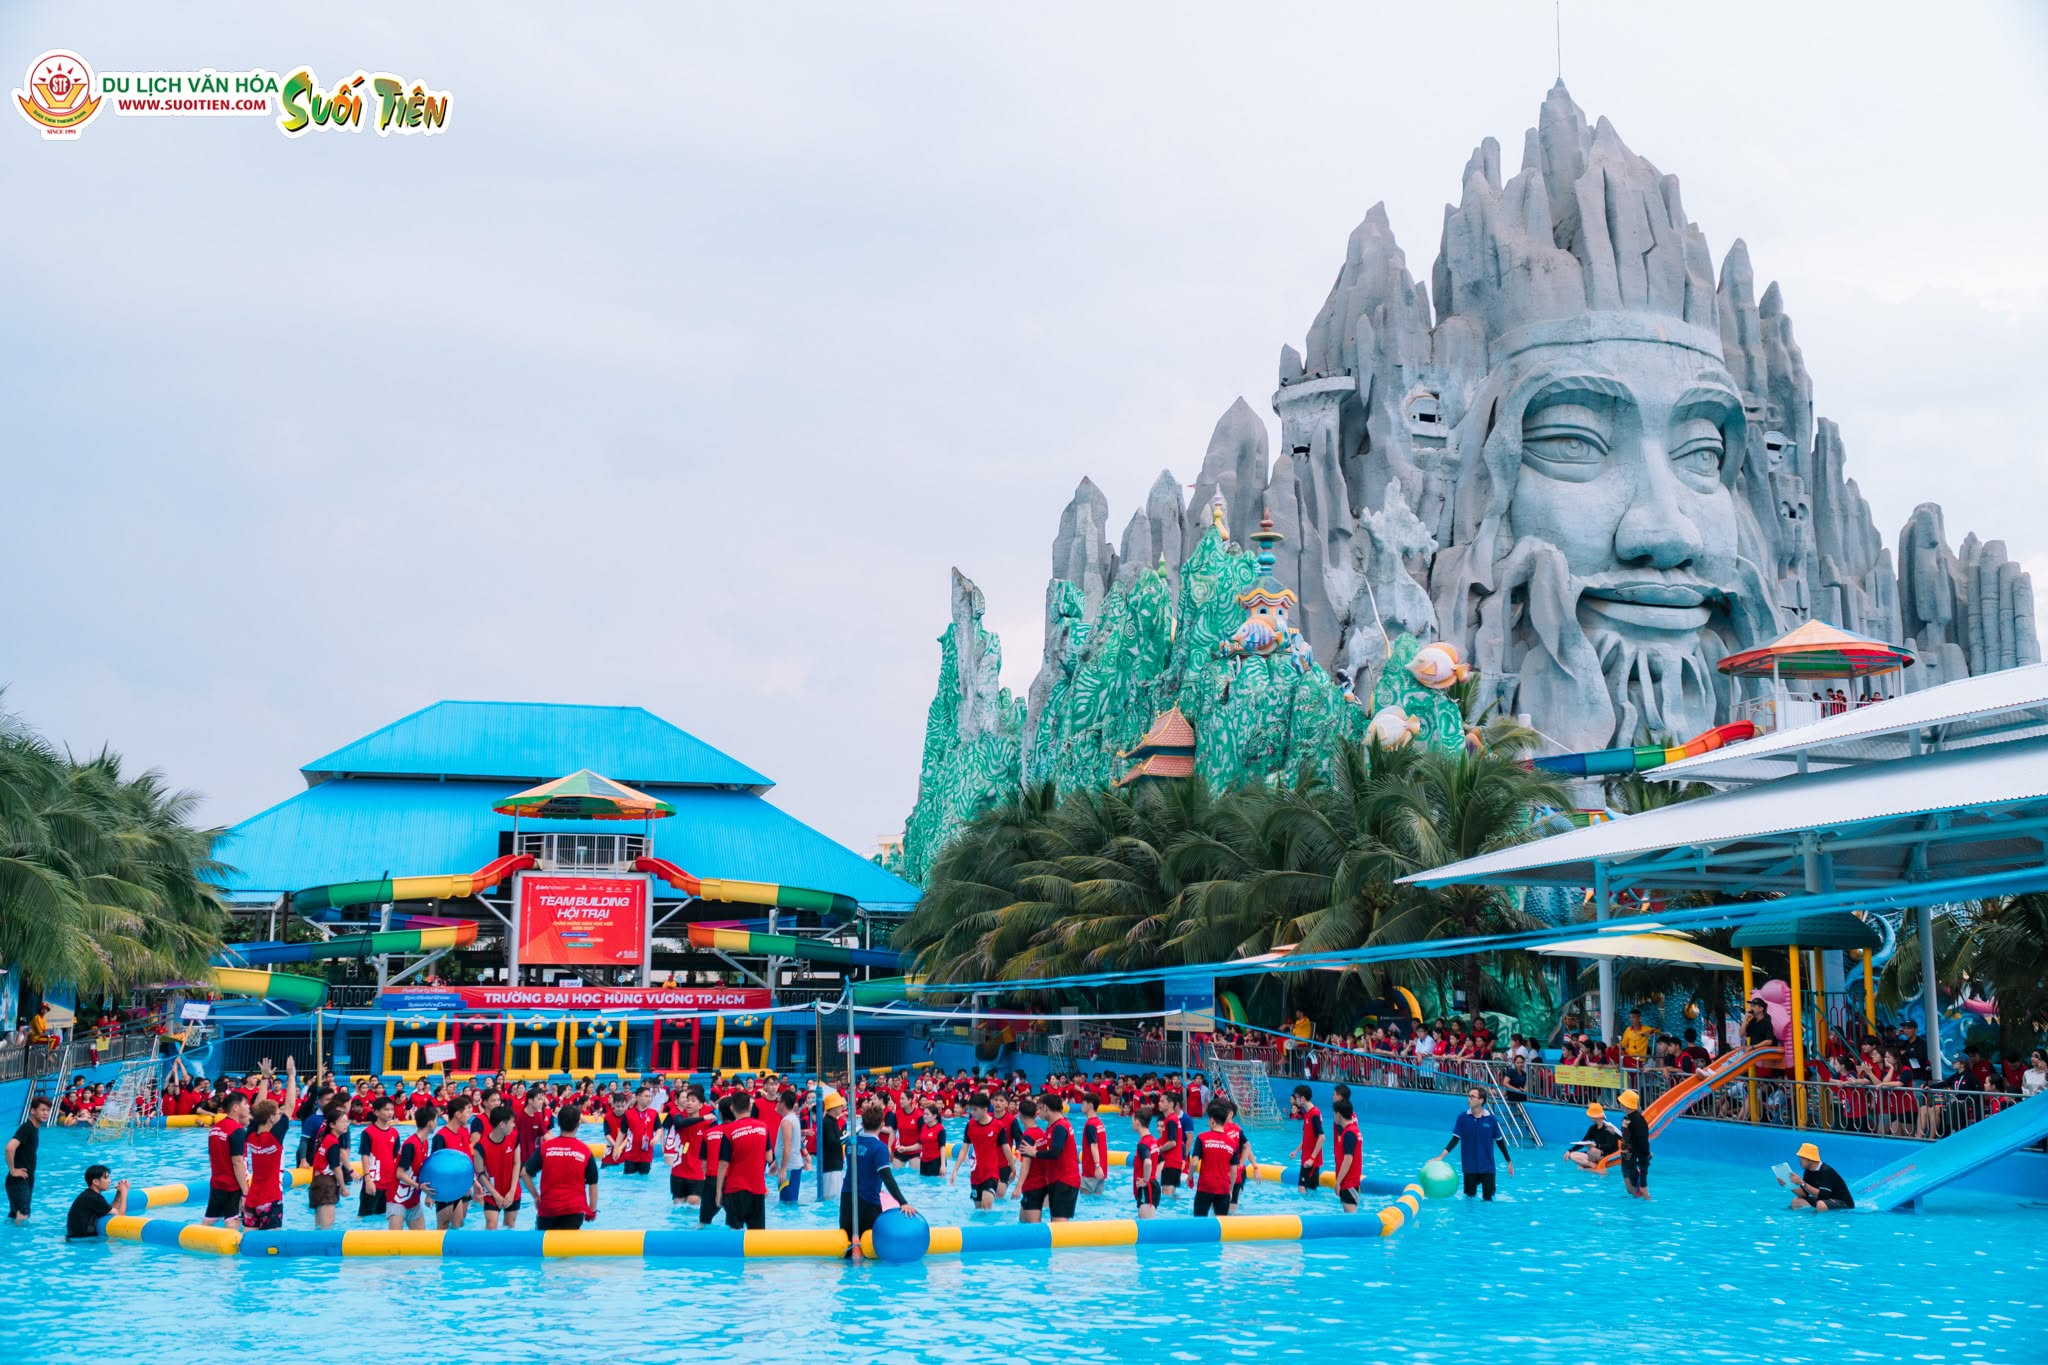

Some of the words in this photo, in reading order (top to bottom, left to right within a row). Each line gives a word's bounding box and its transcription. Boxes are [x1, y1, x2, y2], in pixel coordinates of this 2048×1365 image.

[557, 907, 579, 920] HỘI
[581, 908, 610, 921] TRẠI
[484, 990, 541, 1004] TRƯỜNG
[544, 993, 569, 1006] ĐẠI
[572, 993, 601, 1006] HỌC
[604, 991, 643, 1004] HÙNG
[646, 992, 693, 1005] VƯƠNG
[696, 994, 745, 1005] TP.HCM
